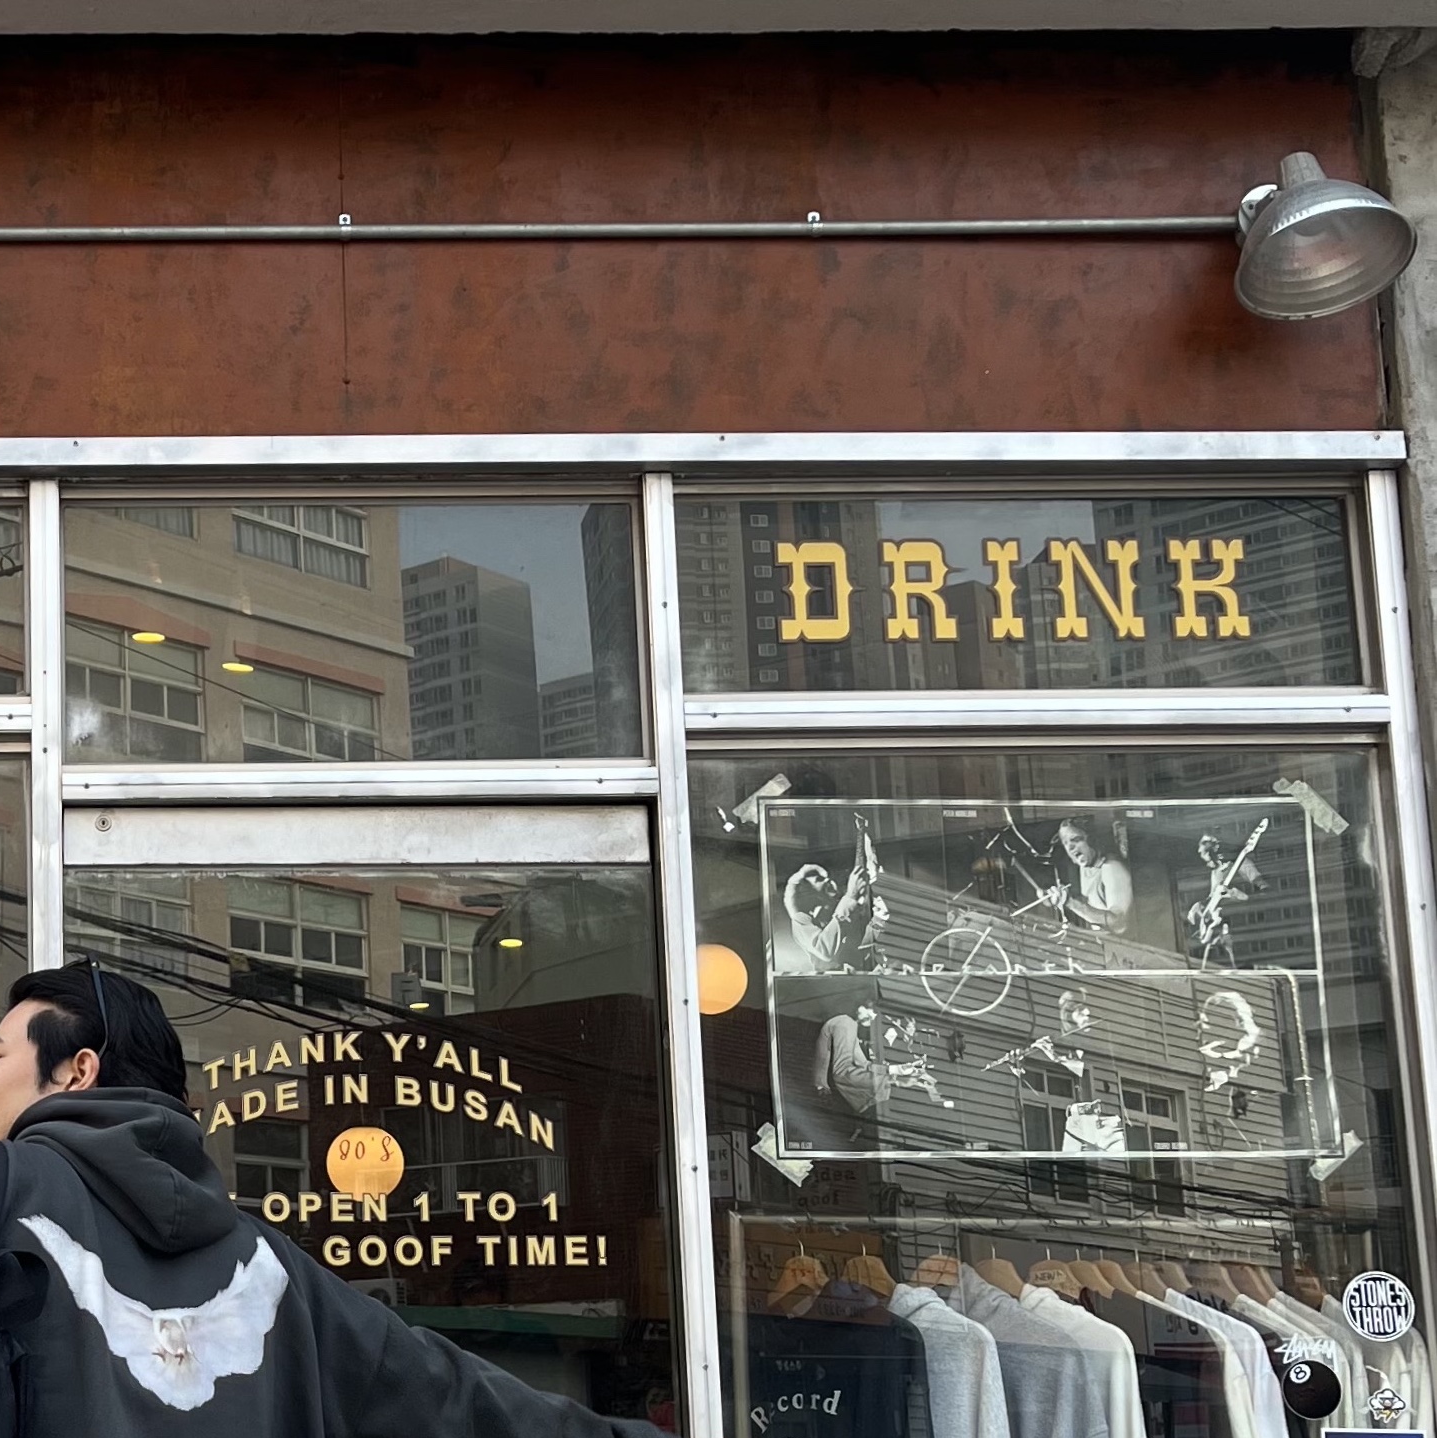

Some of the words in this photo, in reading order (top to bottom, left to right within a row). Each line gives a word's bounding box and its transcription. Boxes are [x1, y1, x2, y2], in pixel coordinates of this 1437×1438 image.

[775, 537, 1251, 643] DRINK
[202, 1031, 364, 1091] THANK
[381, 1031, 523, 1094] Y'ALL
[193, 1079, 300, 1137] ADE
[324, 1074, 369, 1105] IN
[394, 1075, 556, 1151] BUSAN
[263, 1192, 389, 1223] OPEN
[413, 1192, 431, 1223] 1
[457, 1192, 516, 1223] TO
[541, 1192, 559, 1223] 1
[323, 1235, 454, 1267] GOOF
[476, 1235, 608, 1267] TIME!
[1351, 1280, 1407, 1308] STONES
[1353, 1306, 1407, 1334] THROW
[1293, 1366, 1307, 1380] 8
